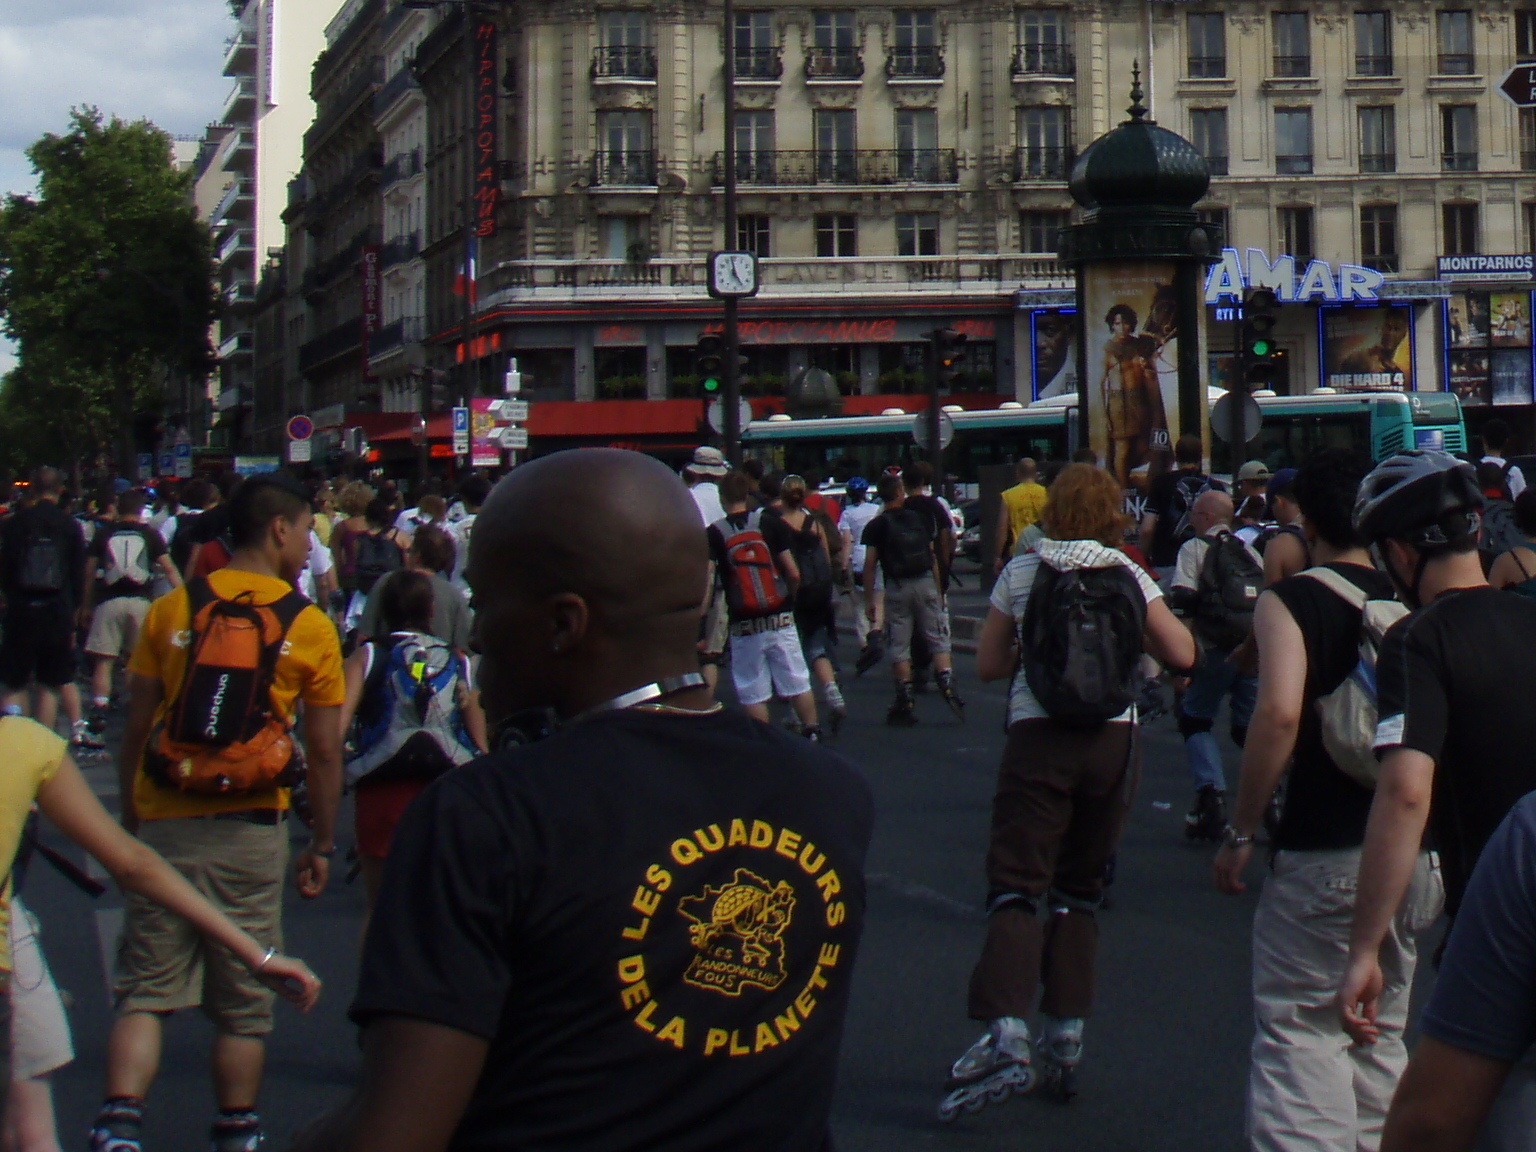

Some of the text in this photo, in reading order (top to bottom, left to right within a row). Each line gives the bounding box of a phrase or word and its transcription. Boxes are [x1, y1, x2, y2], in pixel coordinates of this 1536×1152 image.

[475, 24, 498, 237] HIPPOPOTAMUS
[1439, 256, 1534, 271] MONTPARNOS
[1330, 372, 1404, 386] DIE HARD 4
[1153, 430, 1168, 445] 10
[621, 817, 847, 941] LES QUADEURS
[694, 968, 738, 989] FOUS
[617, 941, 843, 1058] DE LA PLANETE
